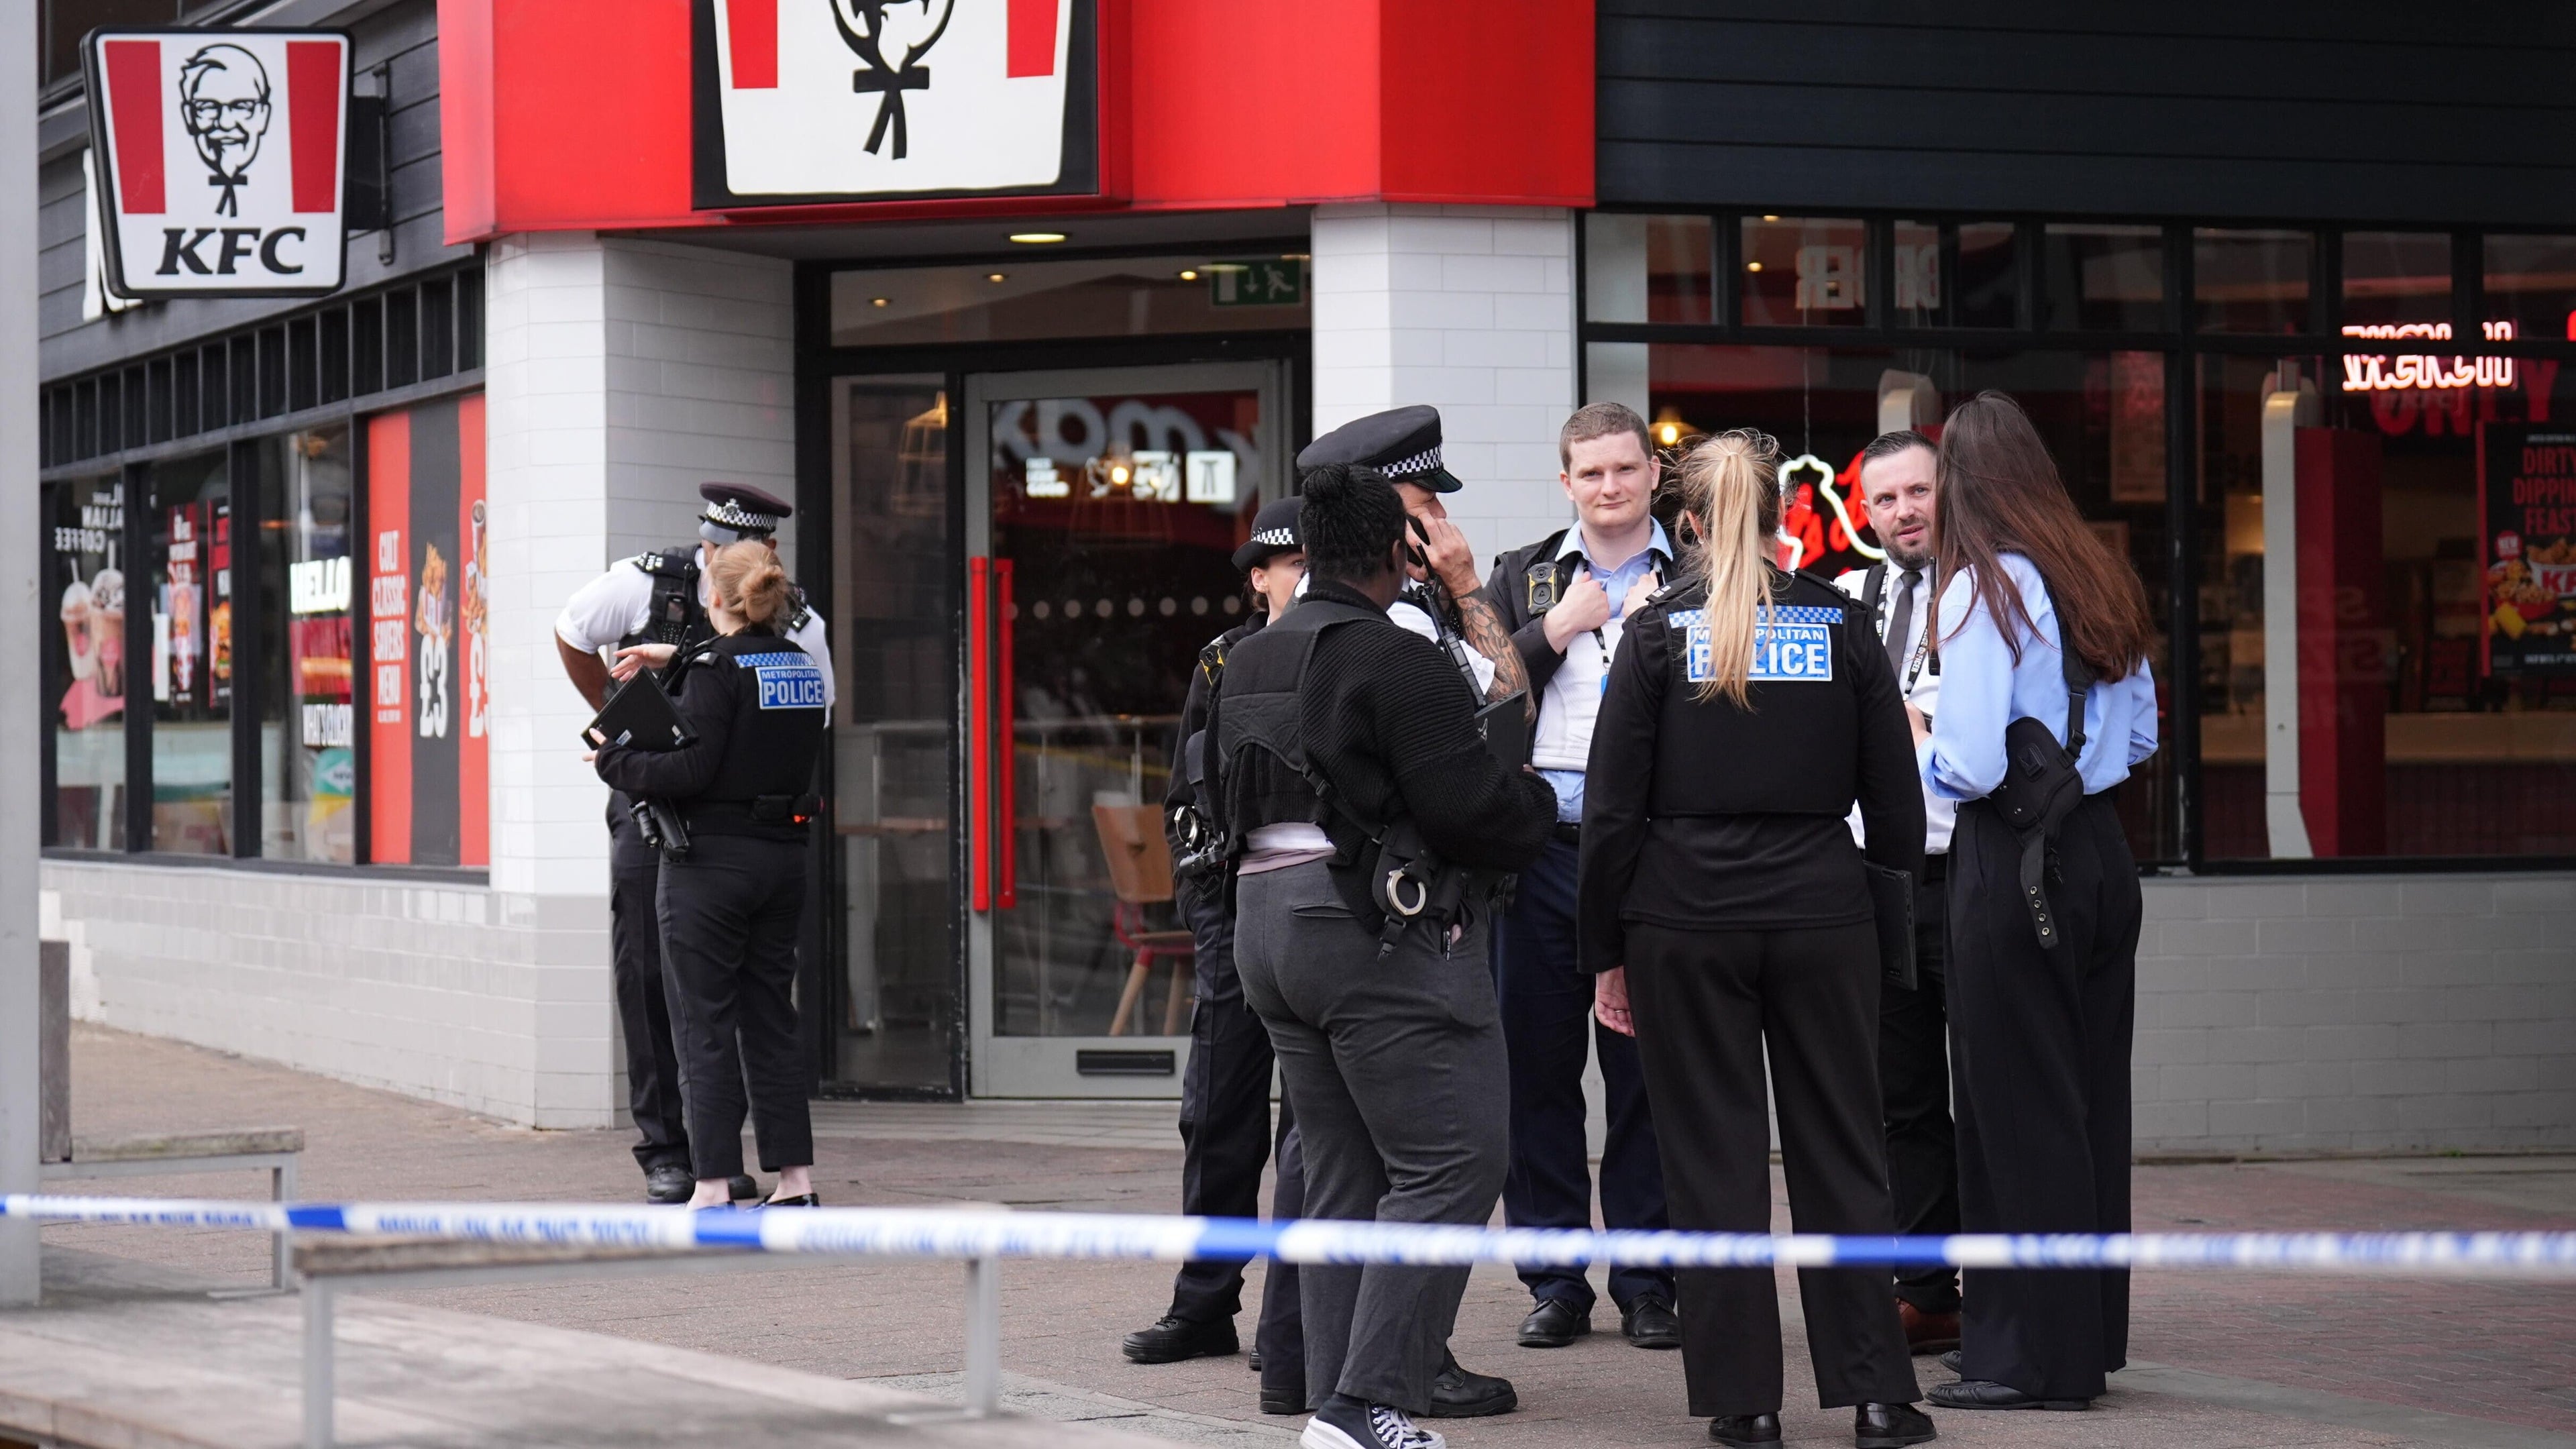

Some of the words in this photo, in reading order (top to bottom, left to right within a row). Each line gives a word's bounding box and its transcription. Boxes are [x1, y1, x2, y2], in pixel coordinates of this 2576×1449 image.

[155, 227, 307, 275] KFC
[379, 531, 399, 572] CULT
[372, 575, 406, 617] CLASSIC
[374, 619, 405, 661] SAVERS
[1694, 642, 1825, 675] PLICE
[377, 665, 401, 705] MENU
[419, 633, 448, 738] £3
[761, 670, 820, 679] METROPOLITAN
[763, 680, 822, 705] POLICE
